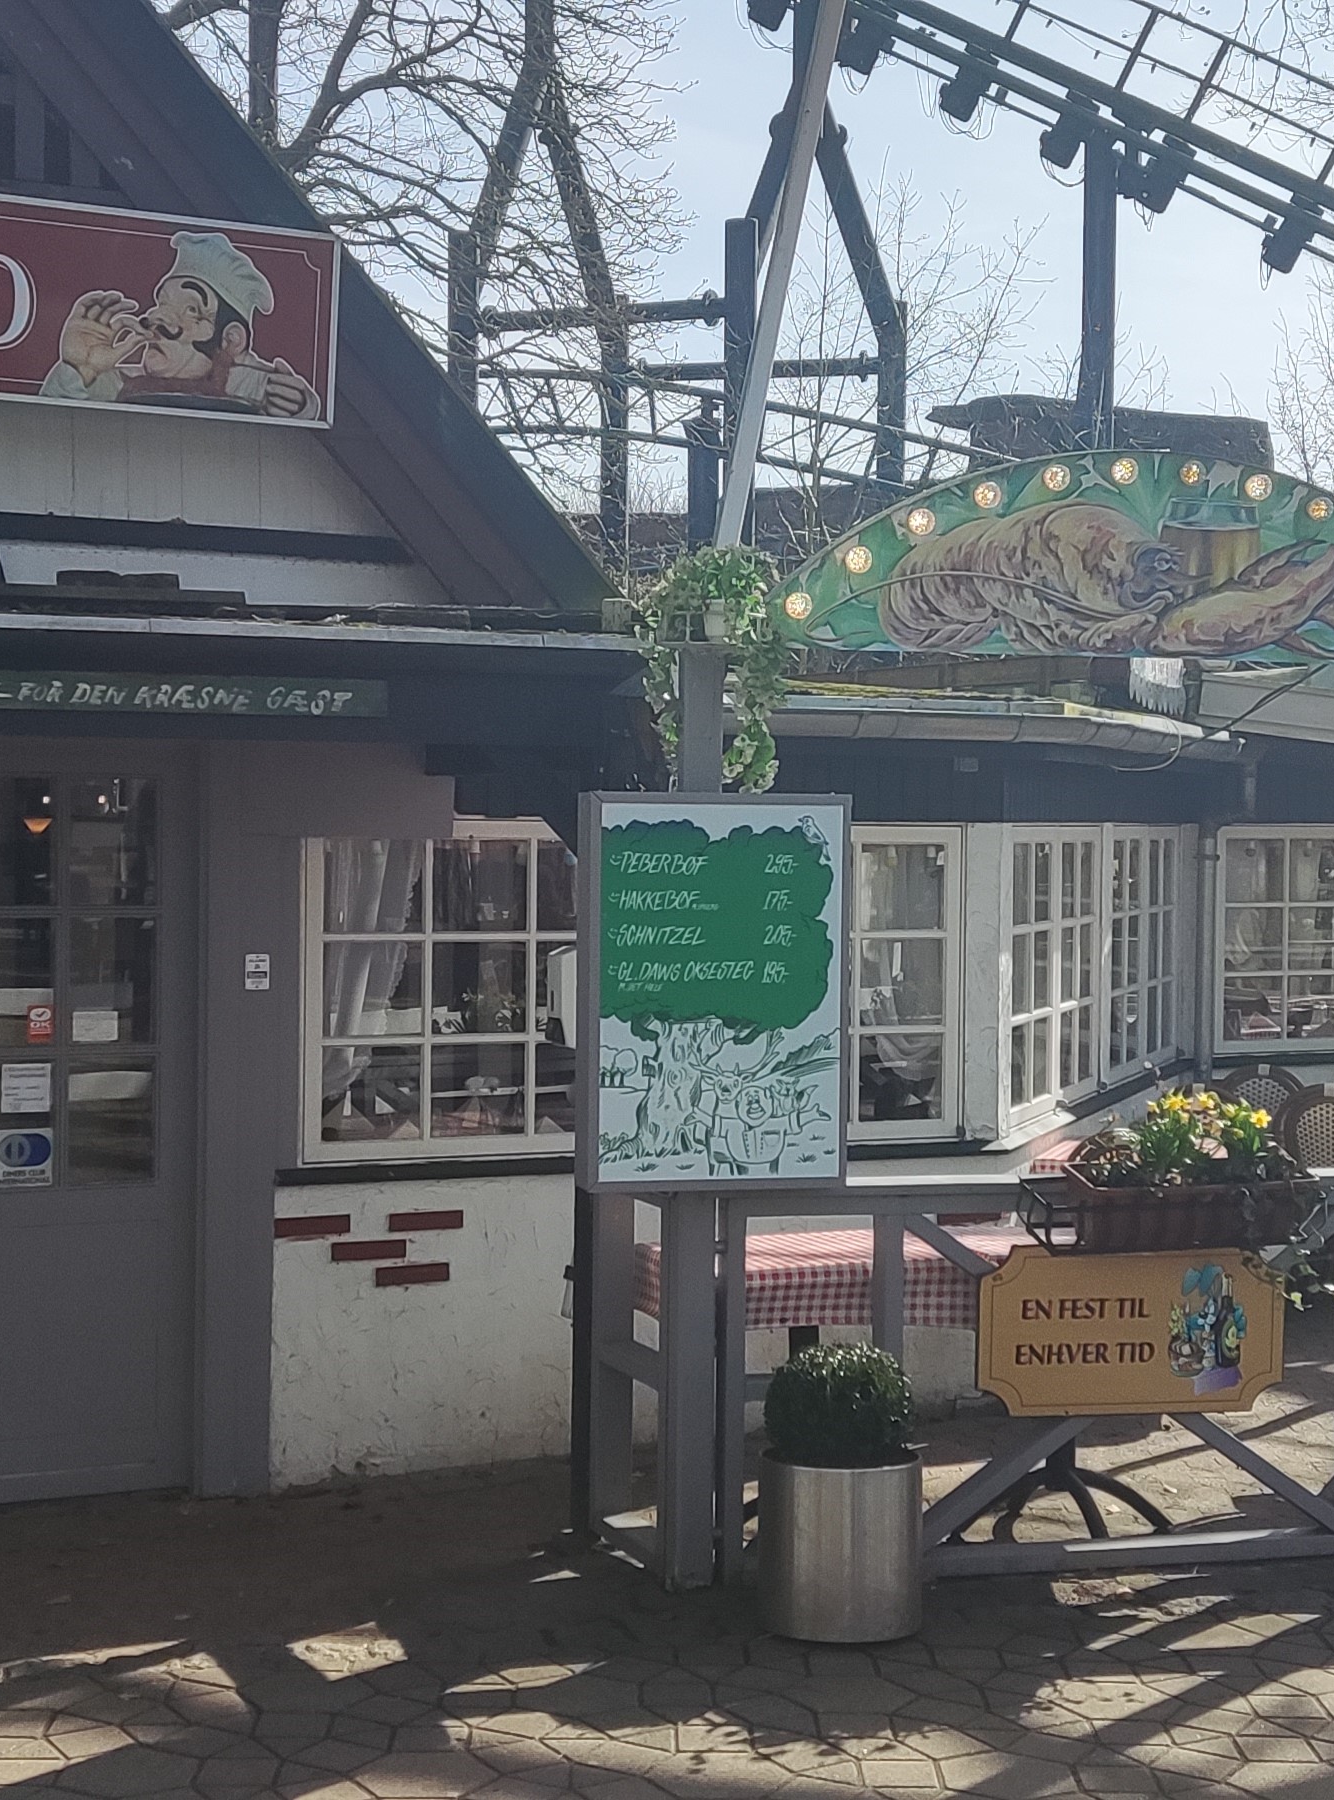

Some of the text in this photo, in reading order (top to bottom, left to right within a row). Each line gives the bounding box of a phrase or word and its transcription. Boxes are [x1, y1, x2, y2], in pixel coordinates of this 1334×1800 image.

[68, 683, 124, 705] DEN
[133, 684, 254, 712] KRÆSNE
[266, 687, 354, 716] GÆST
[617, 923, 707, 946] SCHNITZEL
[683, 960, 755, 982] OKSESTEG
[29, 1021, 51, 1029] OK
[1021, 1298, 1152, 1321] EN FEST TIL
[1014, 1342, 1156, 1366] ENHVER TID
